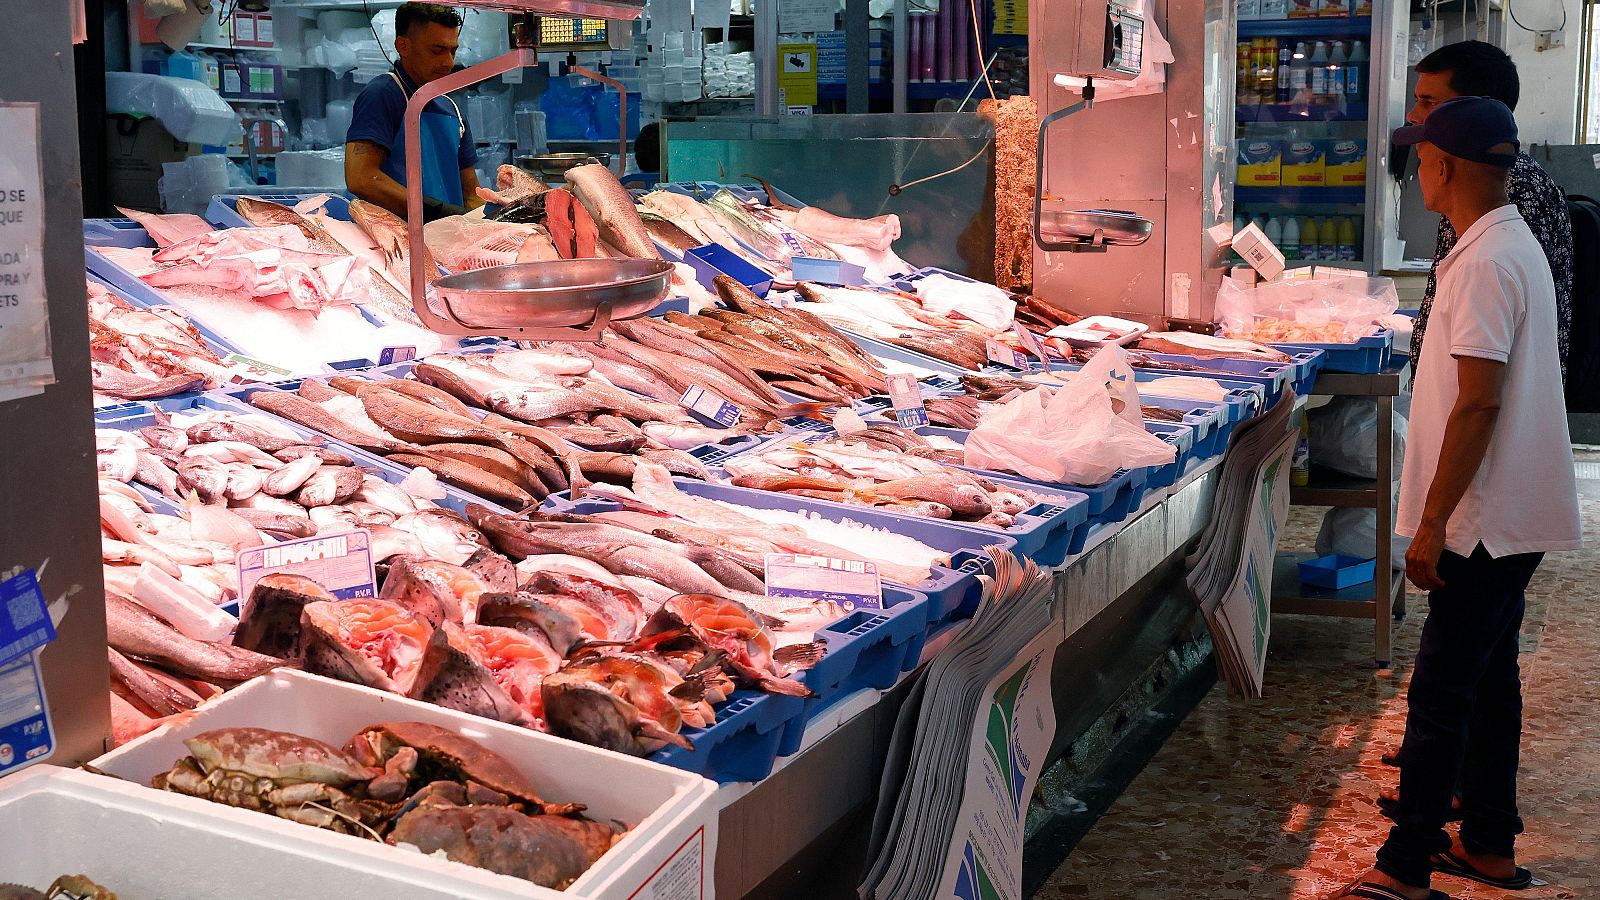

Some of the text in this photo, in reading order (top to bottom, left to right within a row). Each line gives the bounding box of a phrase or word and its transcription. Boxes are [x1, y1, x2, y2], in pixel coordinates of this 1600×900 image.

[9, 190, 25, 202] SE
[22, 272, 30, 284] Y
[355, 588, 371, 598] P.V.P.
